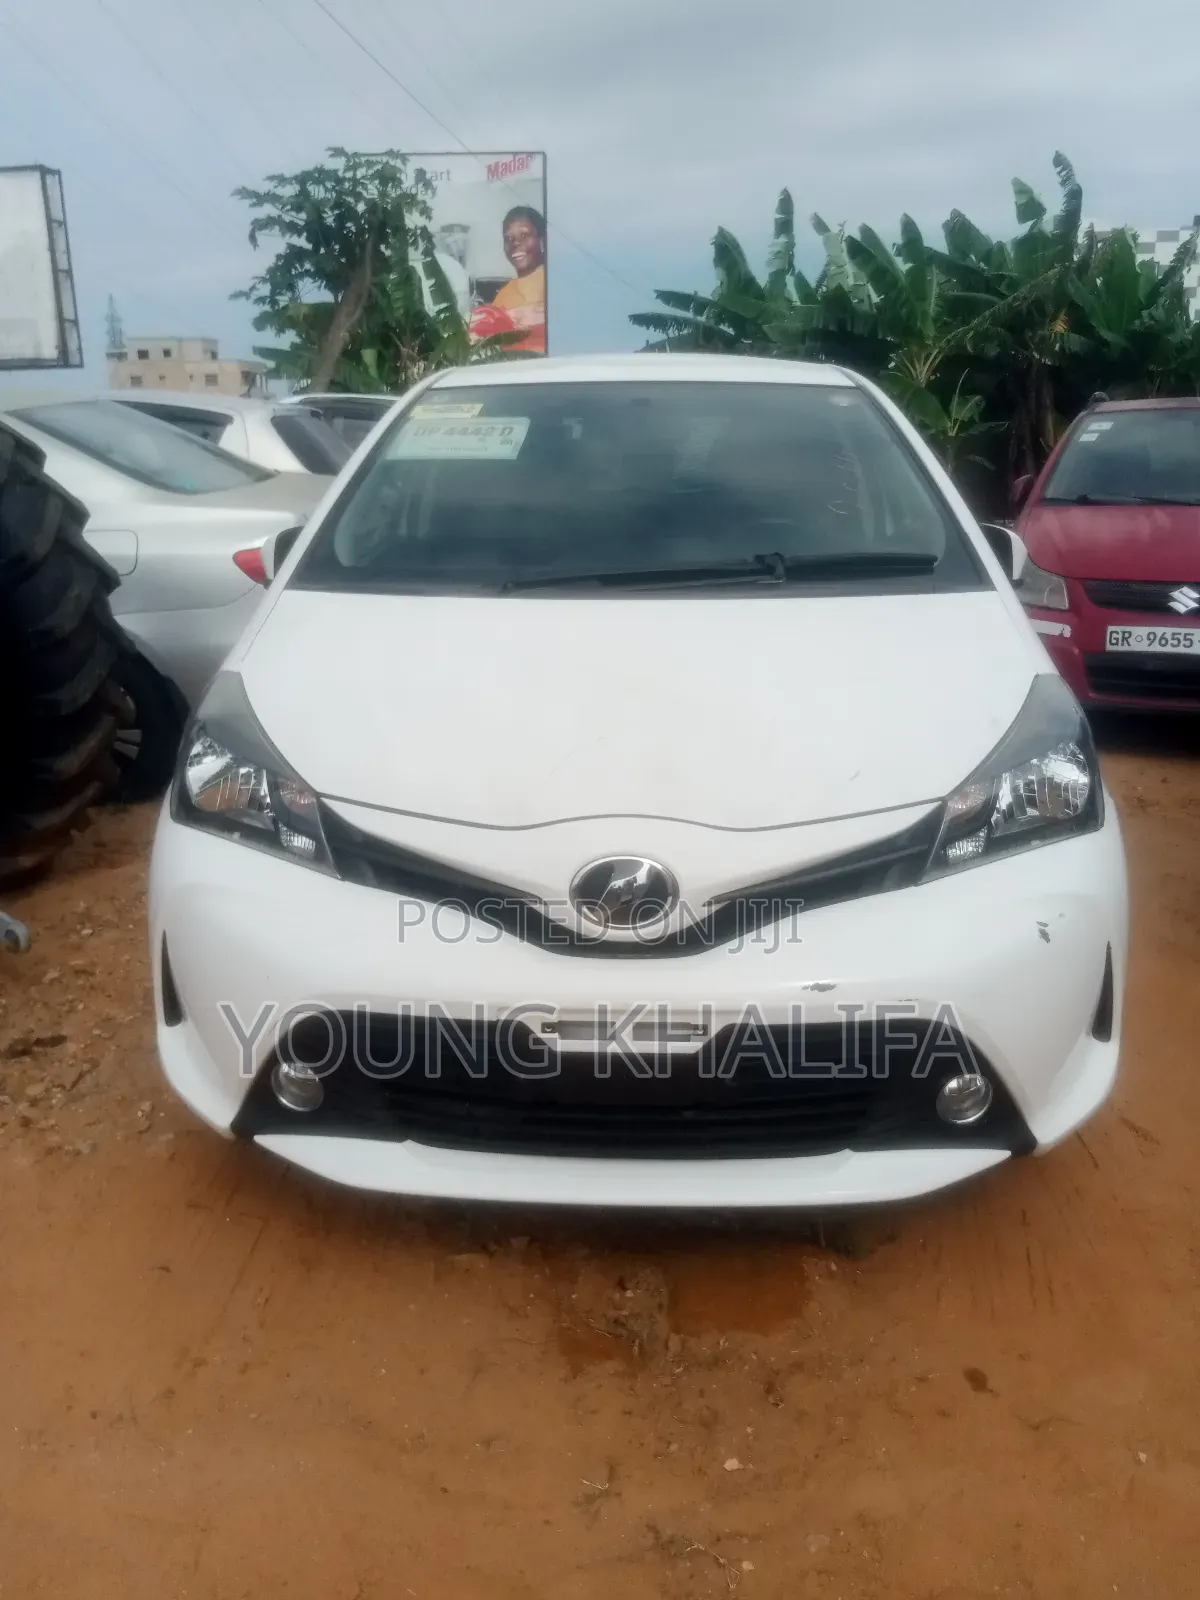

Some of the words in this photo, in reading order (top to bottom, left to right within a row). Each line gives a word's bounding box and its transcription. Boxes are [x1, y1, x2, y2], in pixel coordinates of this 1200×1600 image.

[485, 153, 533, 182] Madar
[1109, 630, 1132, 647] GR
[1146, 631, 1195, 648] 9655
